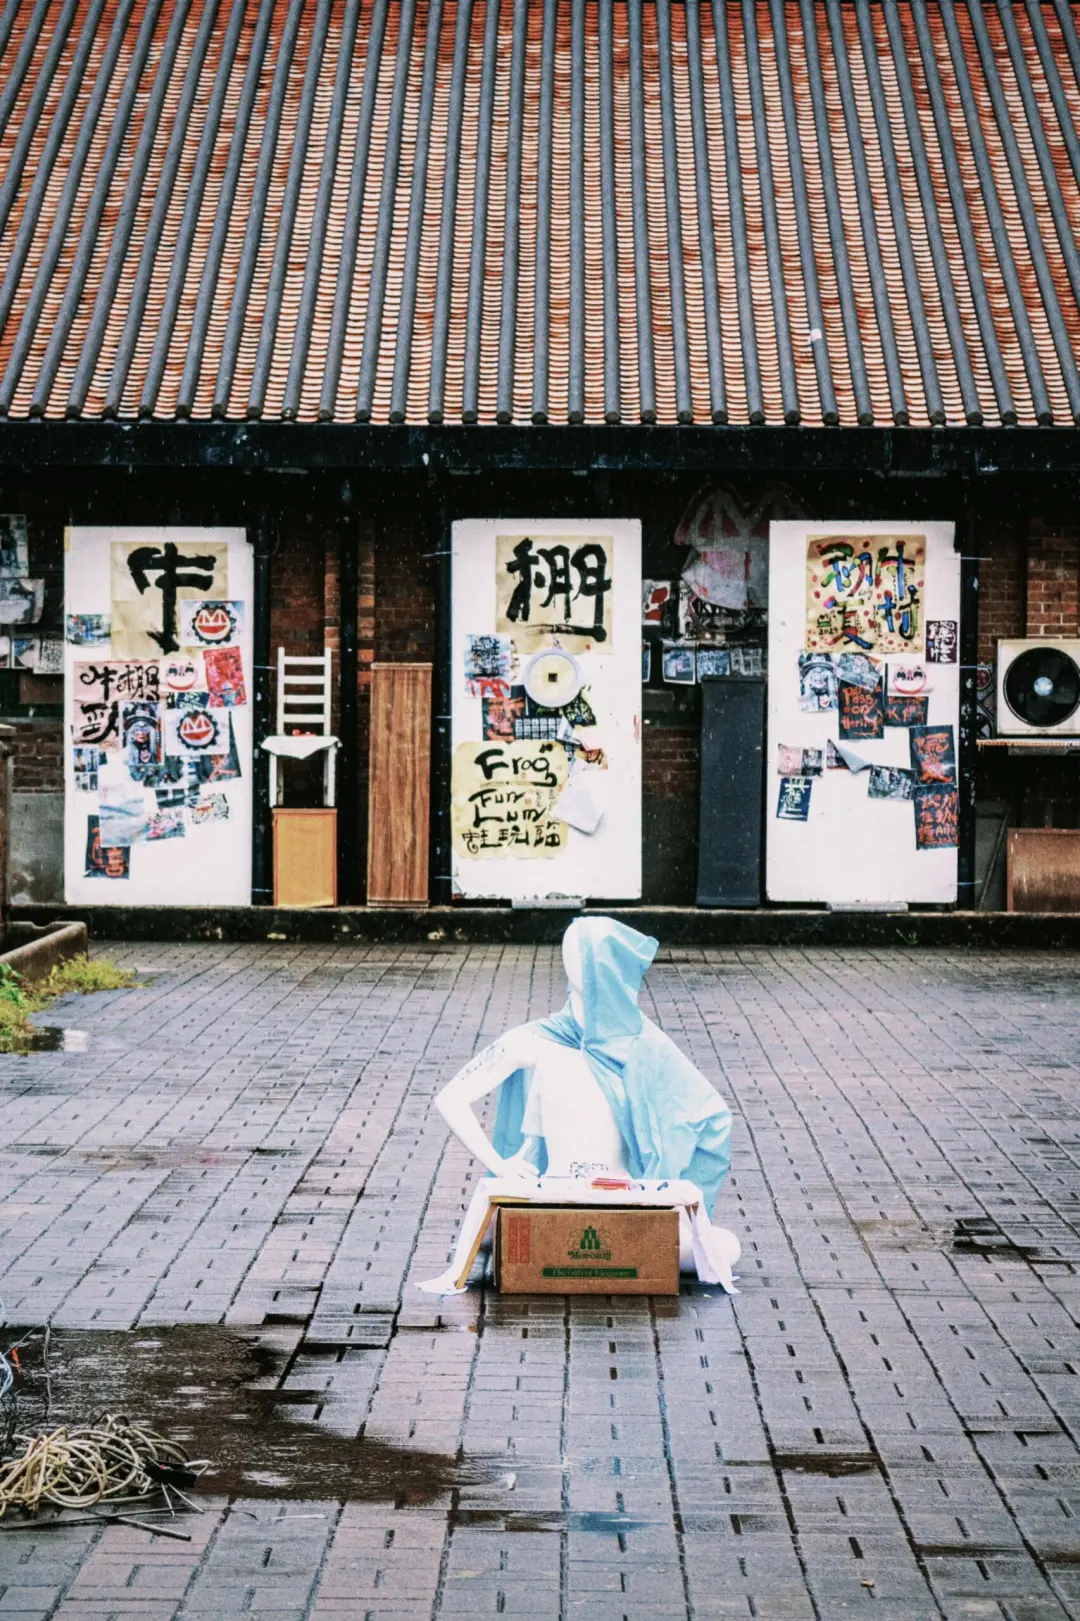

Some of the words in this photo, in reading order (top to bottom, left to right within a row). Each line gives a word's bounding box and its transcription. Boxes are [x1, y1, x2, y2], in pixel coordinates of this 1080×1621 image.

[127, 542, 217, 655] 牛
[474, 748, 558, 787] Frog
[468, 788, 526, 808] Fun
[473, 805, 547, 829] Lum
